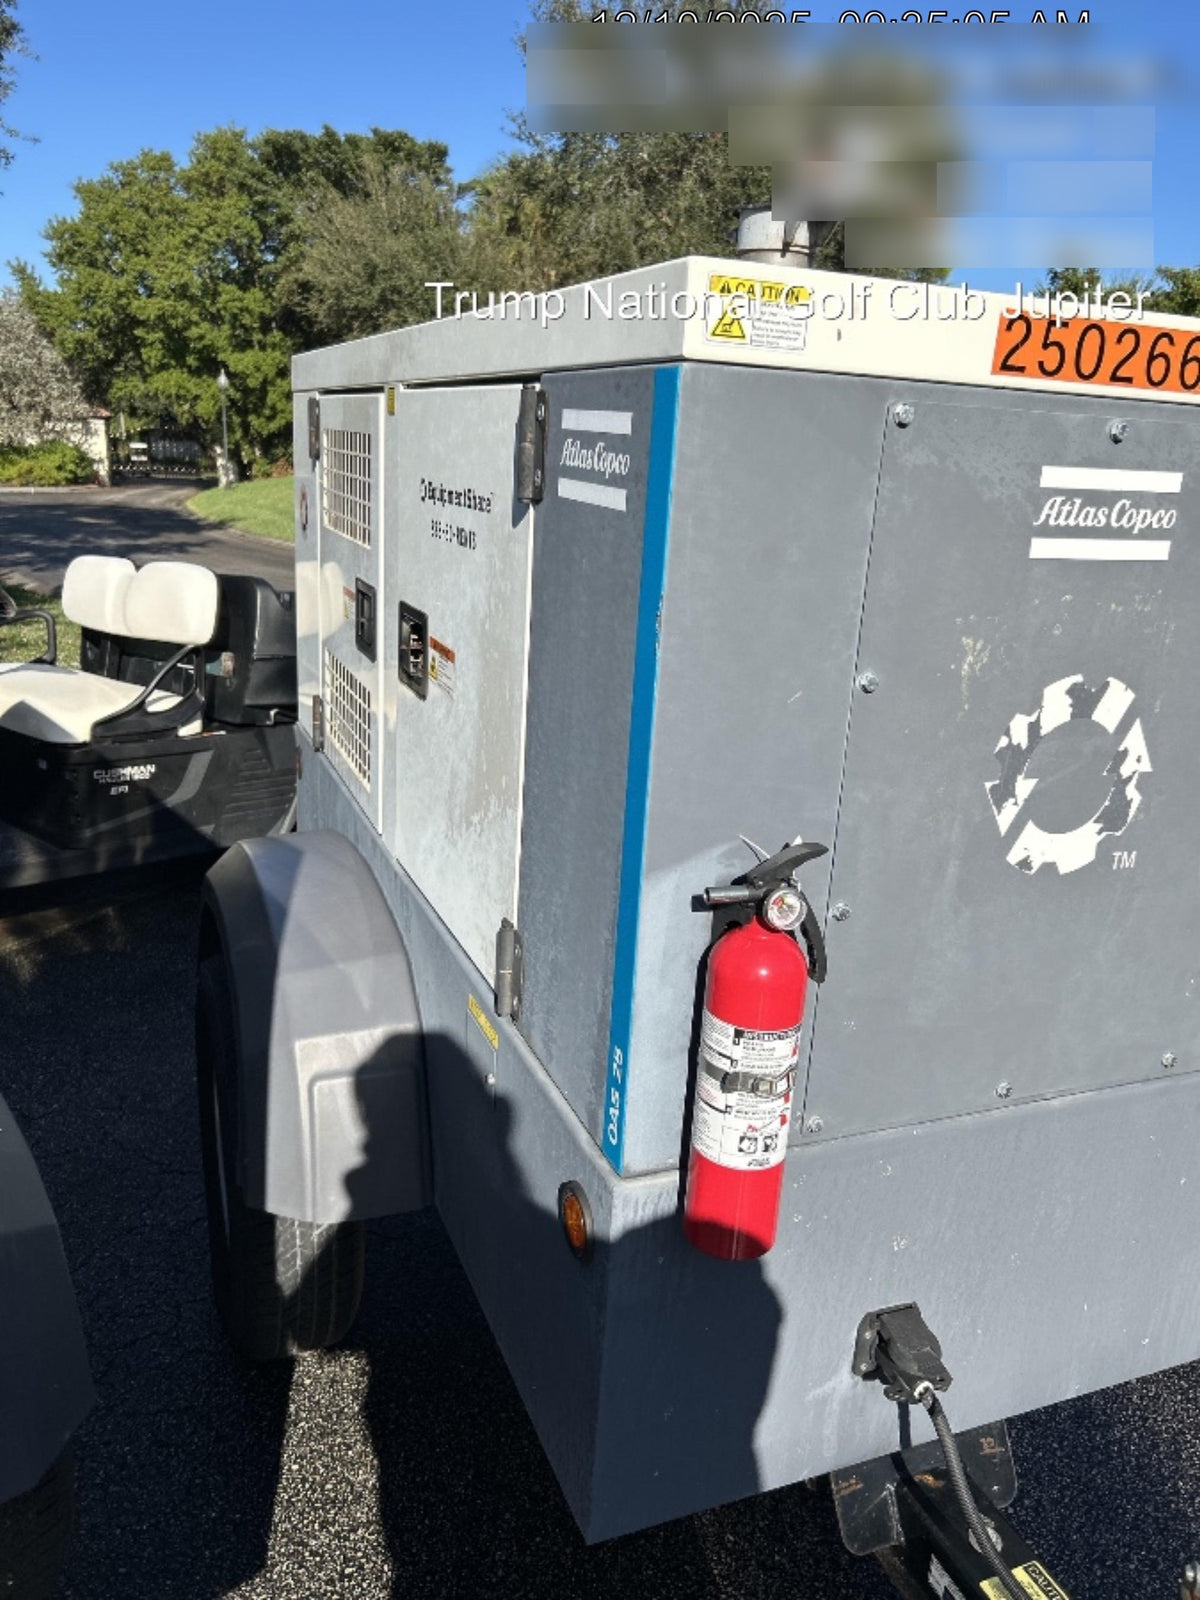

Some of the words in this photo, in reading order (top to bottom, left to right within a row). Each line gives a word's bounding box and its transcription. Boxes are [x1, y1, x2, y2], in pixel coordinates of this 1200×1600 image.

[999, 316, 1200, 391] 250266
[560, 438, 592, 471] Atlas
[593, 441, 630, 479] Copco
[1033, 496, 1108, 528] Atlas
[1110, 499, 1177, 535] Copco
[1112, 851, 1137, 870] TM
